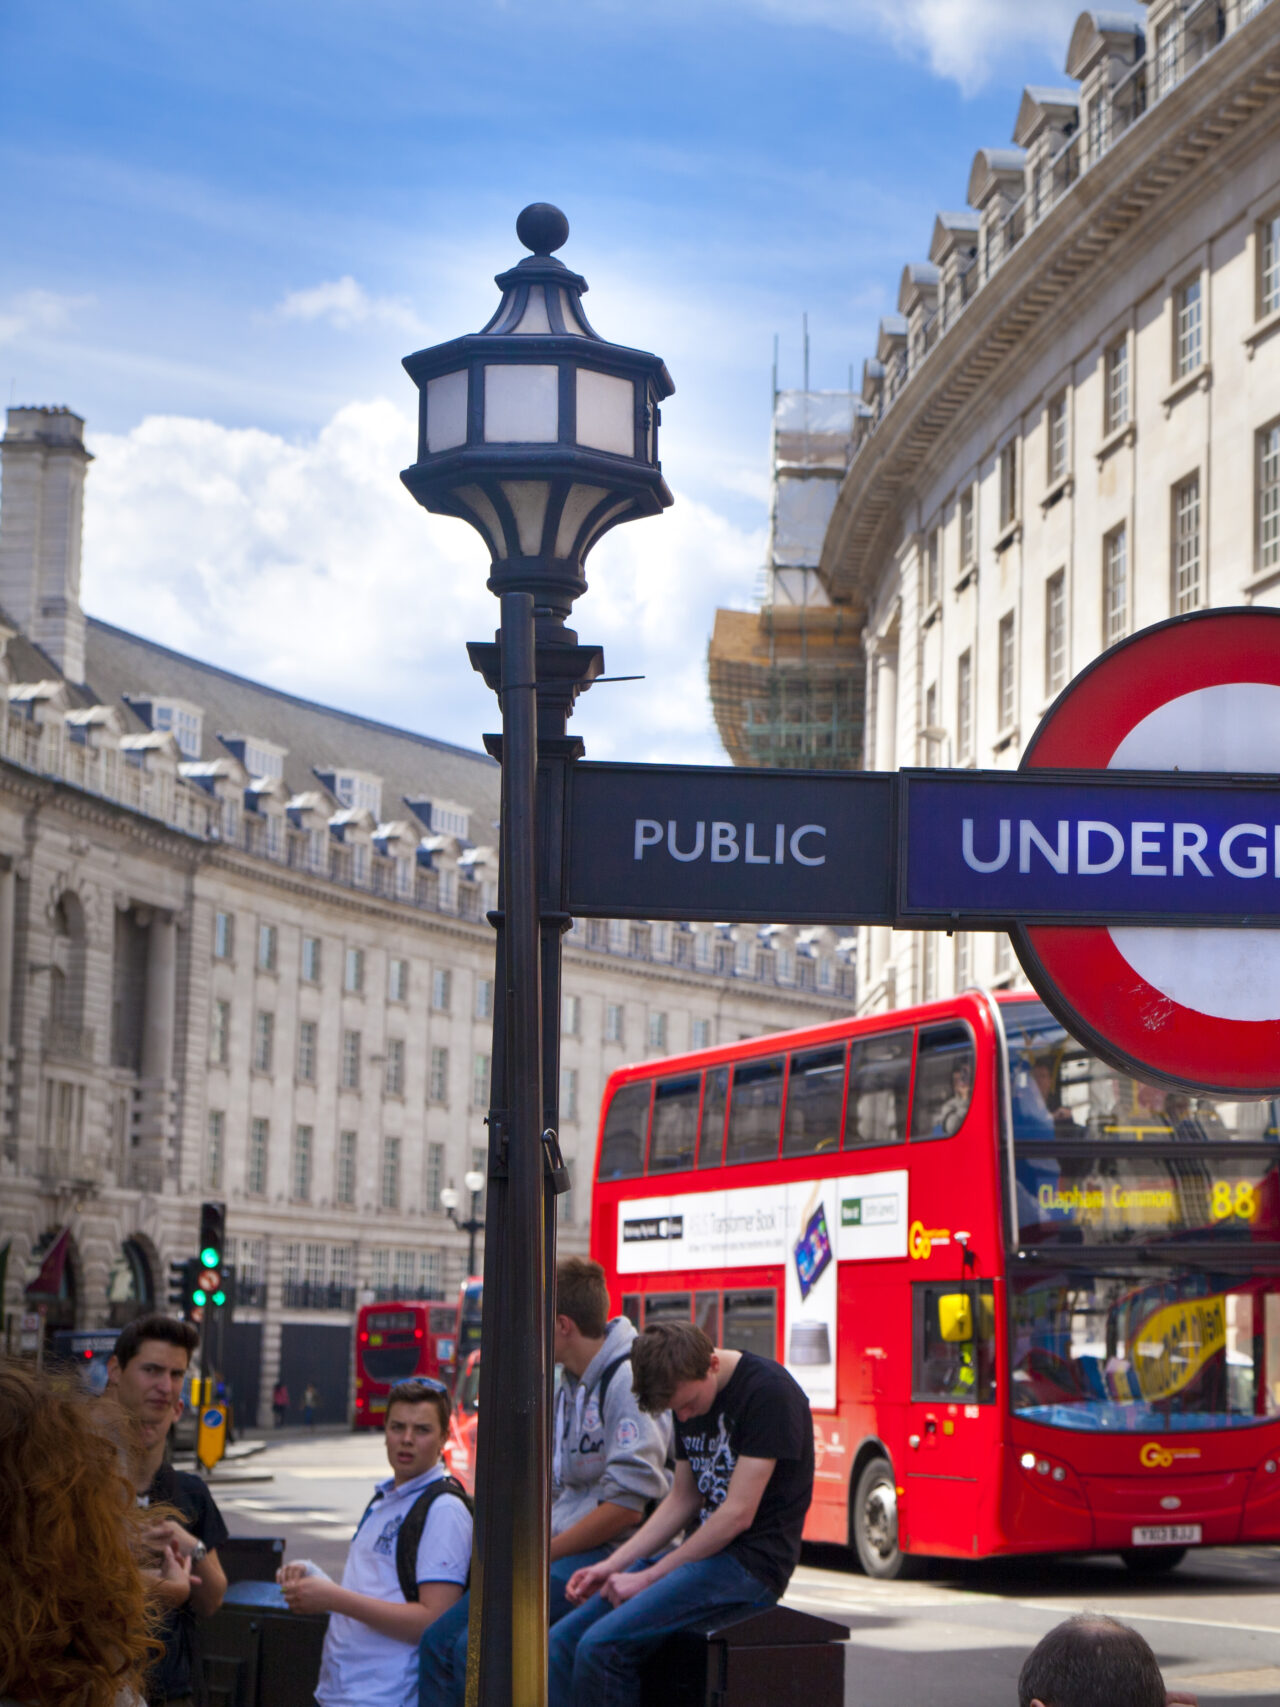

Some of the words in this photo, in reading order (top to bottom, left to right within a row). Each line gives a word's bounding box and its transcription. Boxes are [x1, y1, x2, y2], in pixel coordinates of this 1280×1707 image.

[633, 818, 828, 866] PUBLIC
[1038, 1183, 1105, 1214] Clapham
[1111, 1183, 1173, 1209] Common
[1211, 1180, 1257, 1219] 88
